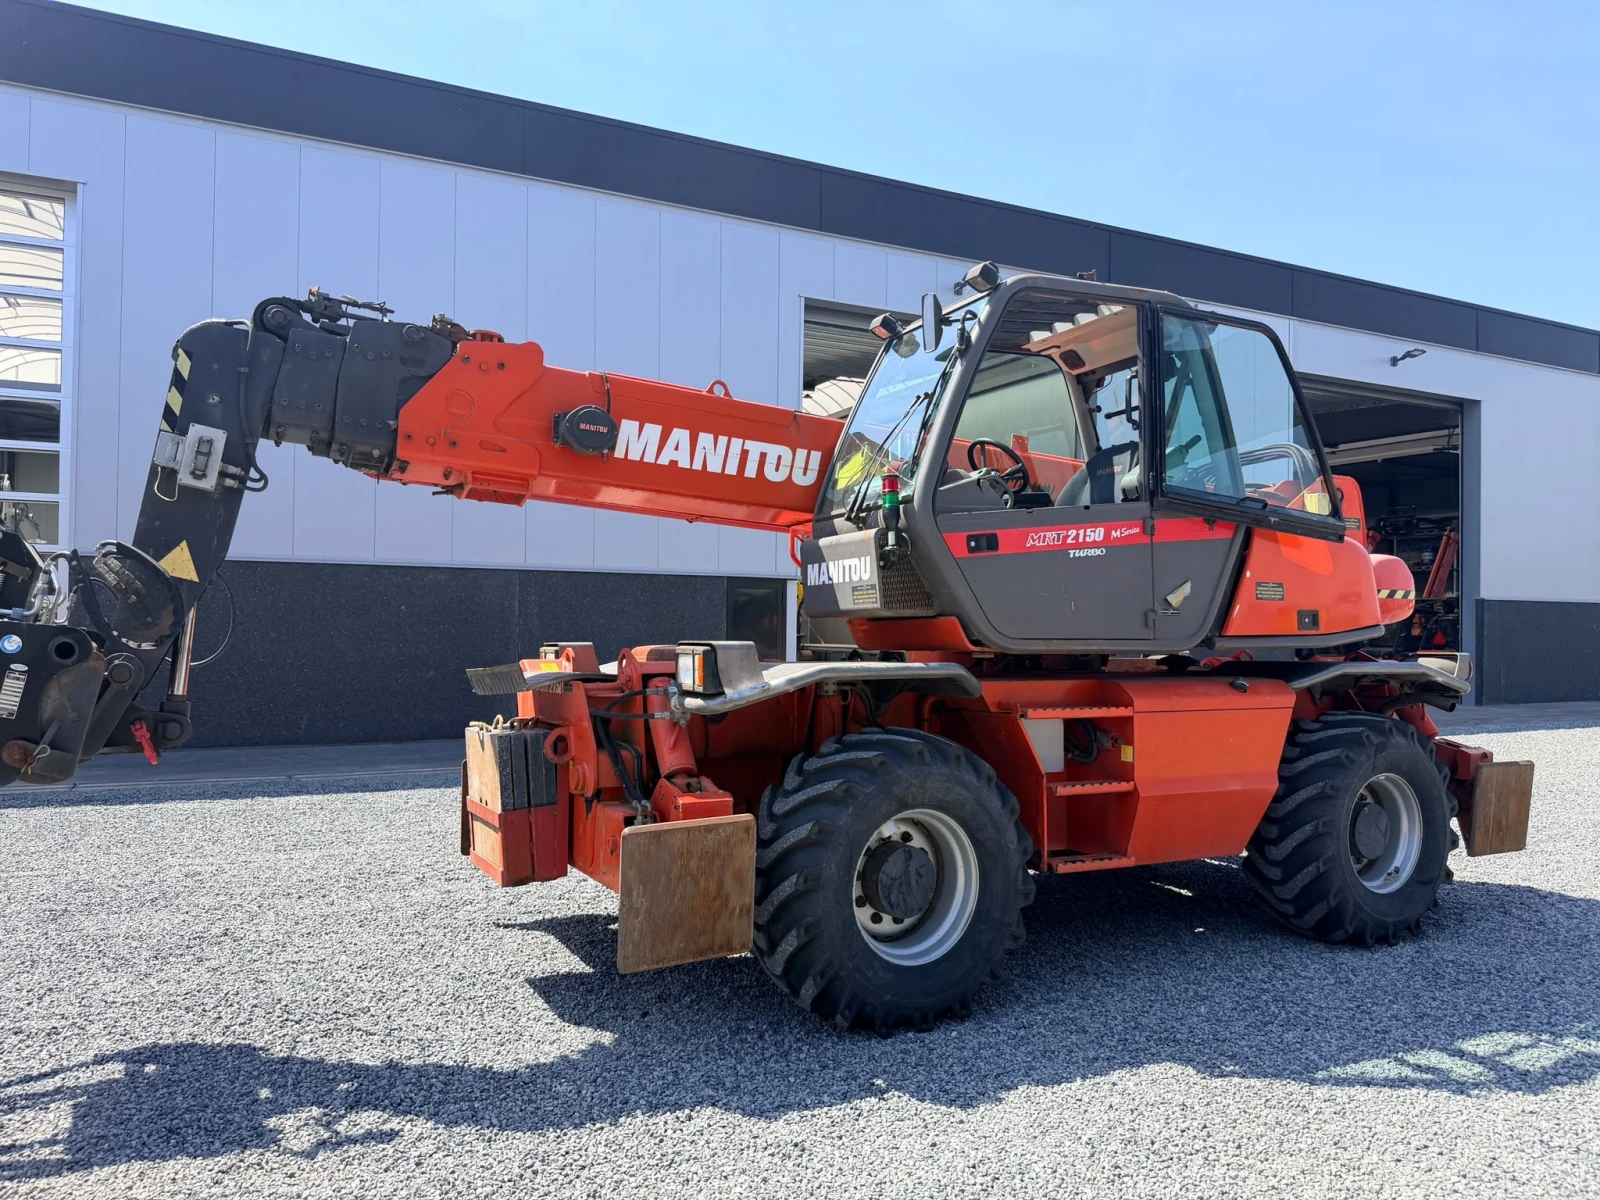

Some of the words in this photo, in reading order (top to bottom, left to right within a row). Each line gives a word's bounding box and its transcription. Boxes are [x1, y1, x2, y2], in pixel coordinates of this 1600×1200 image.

[579, 423, 608, 433] MANITOU
[614, 419, 822, 486] MANITOU
[1026, 531, 1066, 547] MRT
[1066, 527, 1105, 544] 2150
[1111, 529, 1121, 540] M
[1121, 527, 1140, 538] Series
[1068, 547, 1106, 558] TURBO
[807, 556, 871, 586] MANITOU
